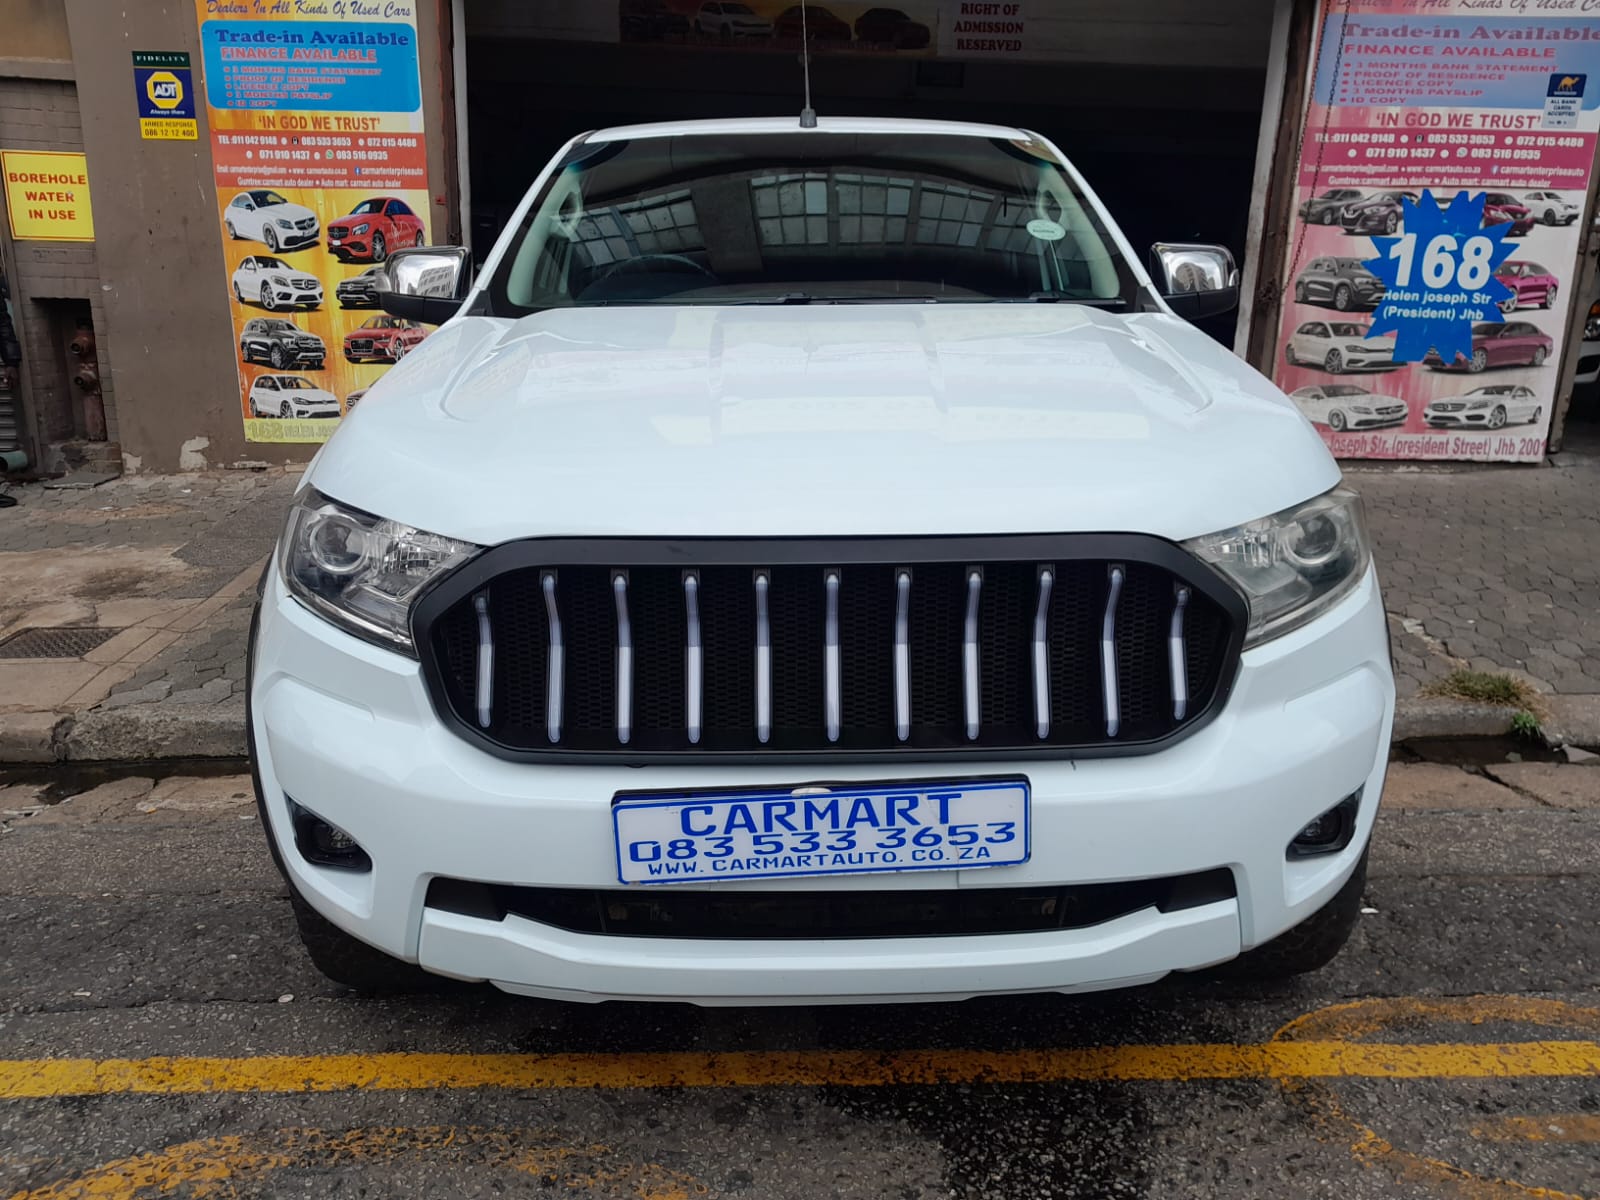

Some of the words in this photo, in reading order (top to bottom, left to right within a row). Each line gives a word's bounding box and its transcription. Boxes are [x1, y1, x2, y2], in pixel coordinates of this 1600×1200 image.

[206, 0, 248, 14] Dealers
[253, 0, 267, 14] In
[270, 1, 291, 14] All
[295, 1, 328, 15] Kinds
[332, 1, 347, 19] Of
[350, 2, 380, 16] Used
[383, 2, 411, 18] Cars
[960, 3, 1001, 16] RIGHT
[1003, 4, 1020, 16] OF
[954, 21, 1024, 34] ADMISSION
[1345, 23, 1461, 39] Trade-in
[214, 29, 304, 45] Trade-in
[309, 31, 409, 47] Available
[956, 38, 1022, 52] RESERVED
[221, 47, 288, 60] FINANCE
[292, 48, 377, 62] AVAILABLE
[1344, 43, 1433, 55] FINANCE
[1441, 45, 1556, 58] AVAILABLE
[1367, 61, 1427, 70] MONTHS
[1431, 62, 1472, 71] BANK
[1476, 63, 1558, 73] STATEMENT
[1354, 70, 1403, 79] PROOF
[1405, 71, 1423, 79] OF
[1427, 71, 1505, 81] RESIDENCE
[154, 83, 177, 97] ADT
[1353, 79, 1412, 87] LICENCE
[1416, 80, 1455, 88] COPY
[1363, 88, 1424, 96] MONTHS
[1427, 88, 1484, 97] PAYSLIP
[1351, 96, 1366, 104] ID
[1368, 96, 1406, 104] COPY
[279, 116, 307, 129] GOD
[311, 117, 332, 130] WE
[1404, 113, 1441, 127] GOD
[1447, 114, 1473, 127] WE
[161, 129, 169, 137] 12
[171, 129, 179, 137] 12
[1516, 135, 1536, 146] 072
[1366, 148, 1386, 158] 071
[1410, 148, 1436, 159] 1437
[1493, 149, 1512, 159] 516
[9, 172, 86, 185] BOREHOLE
[25, 191, 75, 203] WATER
[28, 208, 44, 220] IN
[48, 209, 76, 221] USE
[1389, 232, 1494, 290] 168
[1382, 289, 1420, 301] Helen
[1422, 291, 1468, 305] joseph
[1471, 292, 1492, 304] Str
[1383, 305, 1456, 322] (President)
[1459, 308, 1484, 321] Jhb
[1328, 434, 1367, 457] Joseph
[1370, 435, 1389, 454] Str.
[1392, 435, 1449, 457] (president
[1453, 436, 1491, 457] Street)
[1494, 437, 1515, 455] Jhb
[1518, 438, 1547, 456] 2001
[680, 793, 962, 837] CARMART
[629, 836, 735, 862] 083
[753, 829, 858, 855] 533
[877, 821, 1017, 850] 3653
